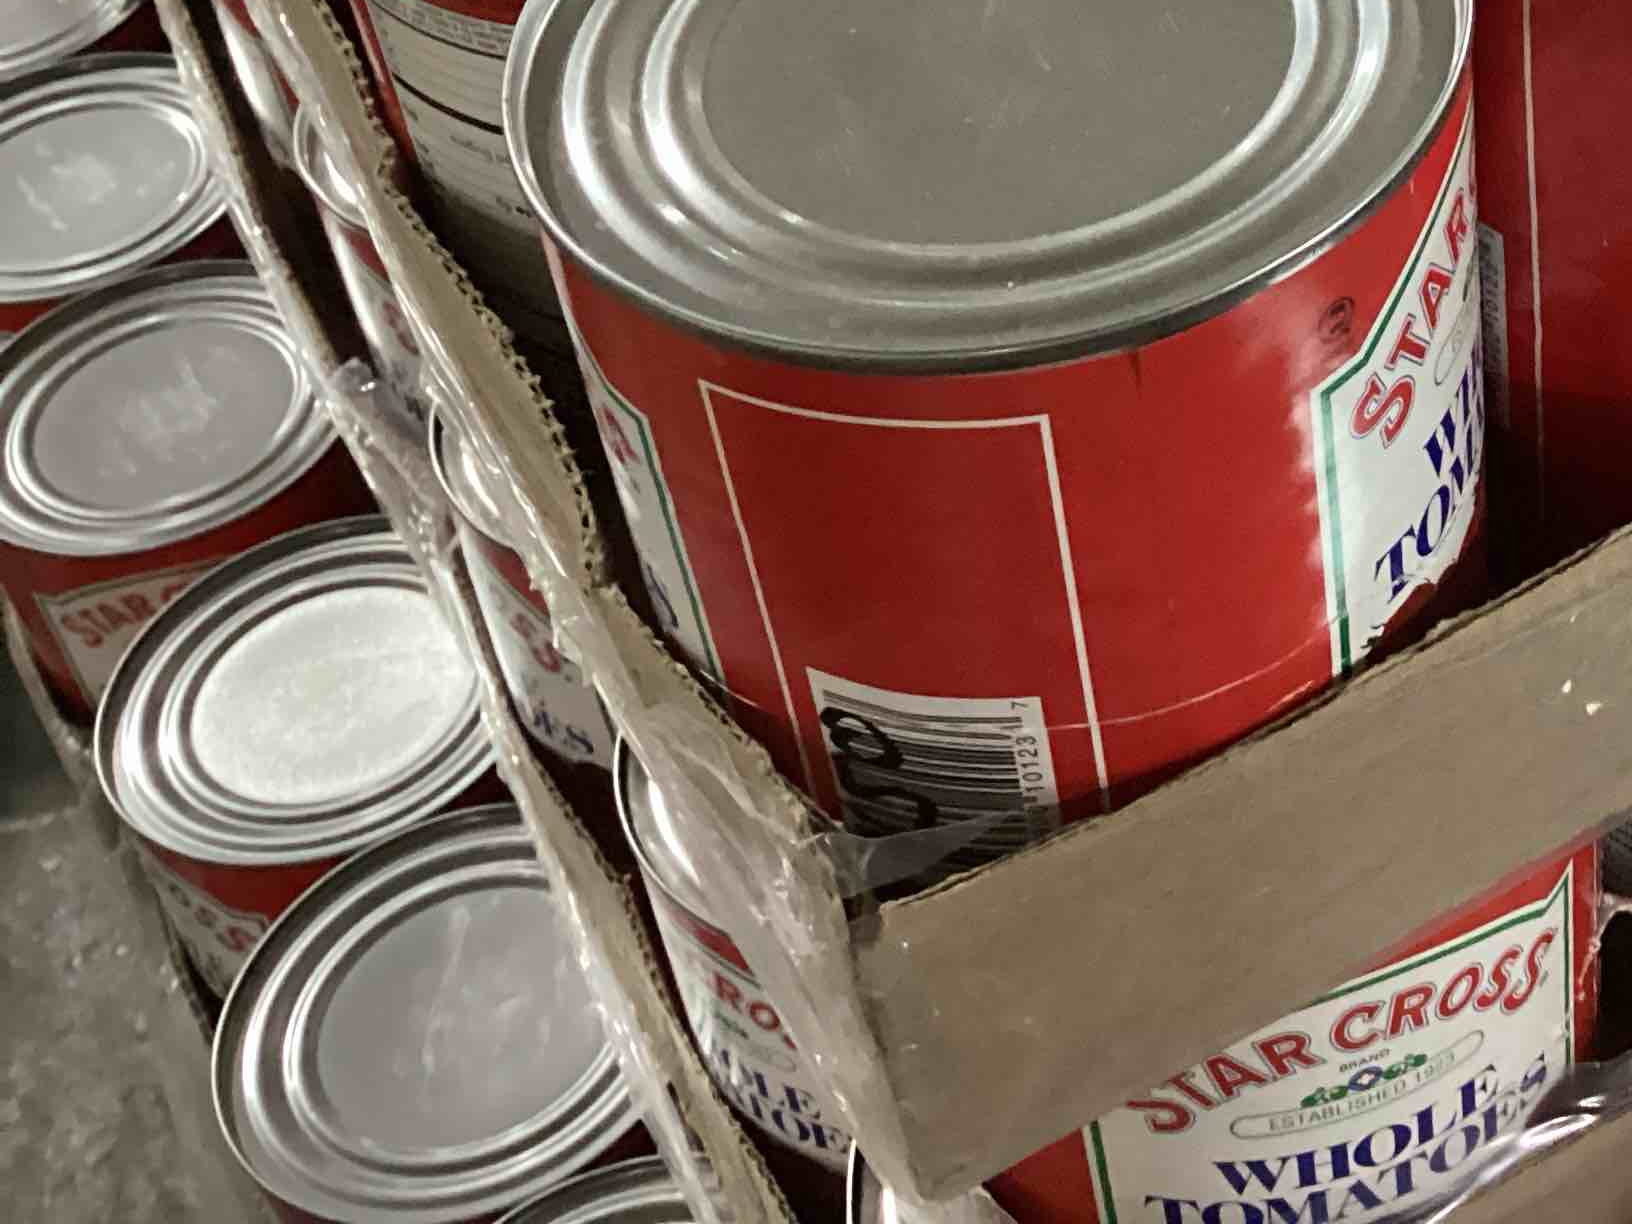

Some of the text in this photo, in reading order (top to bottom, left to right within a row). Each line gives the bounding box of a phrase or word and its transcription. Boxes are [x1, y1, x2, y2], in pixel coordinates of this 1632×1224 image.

[1015, 735, 1045, 793] 10123
[1125, 926, 1560, 1137] STAR CROSS
[1338, 1047, 1391, 1074] BRAND
[1213, 1062, 1499, 1197] WHOLE
[1267, 1077, 1407, 1131] ESTABLISHED
